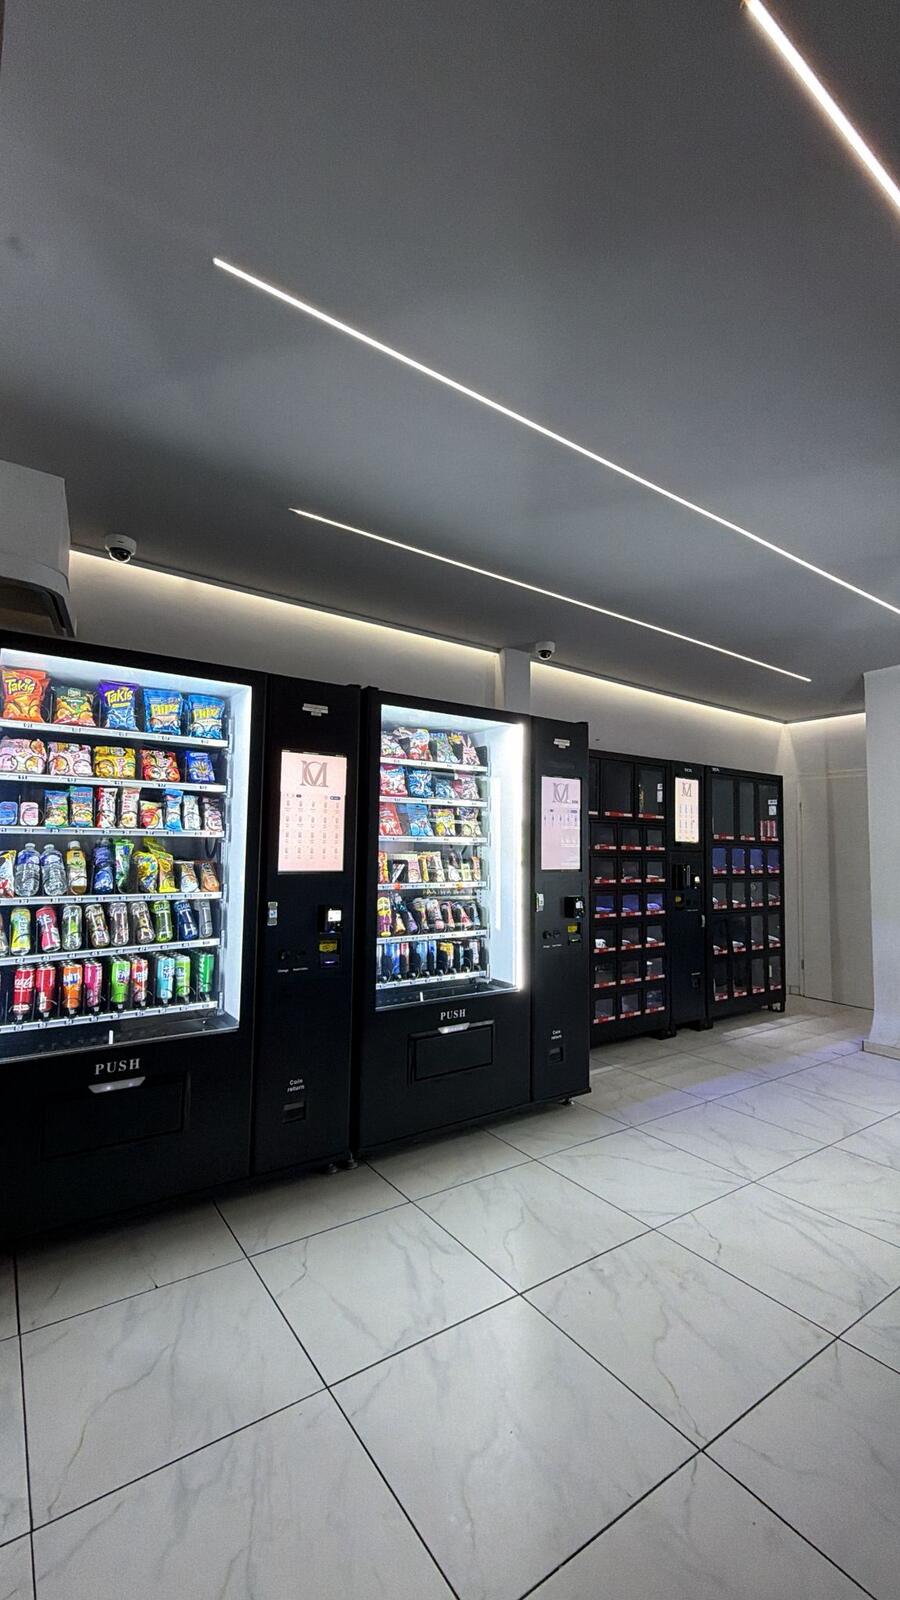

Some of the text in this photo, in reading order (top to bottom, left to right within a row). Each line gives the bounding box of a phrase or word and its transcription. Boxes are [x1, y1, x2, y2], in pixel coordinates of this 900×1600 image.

[4, 678, 36, 694] Takis
[104, 687, 134, 706] Takis
[440, 1008, 466, 1021] PUSH
[94, 1057, 140, 1075] PUSH
